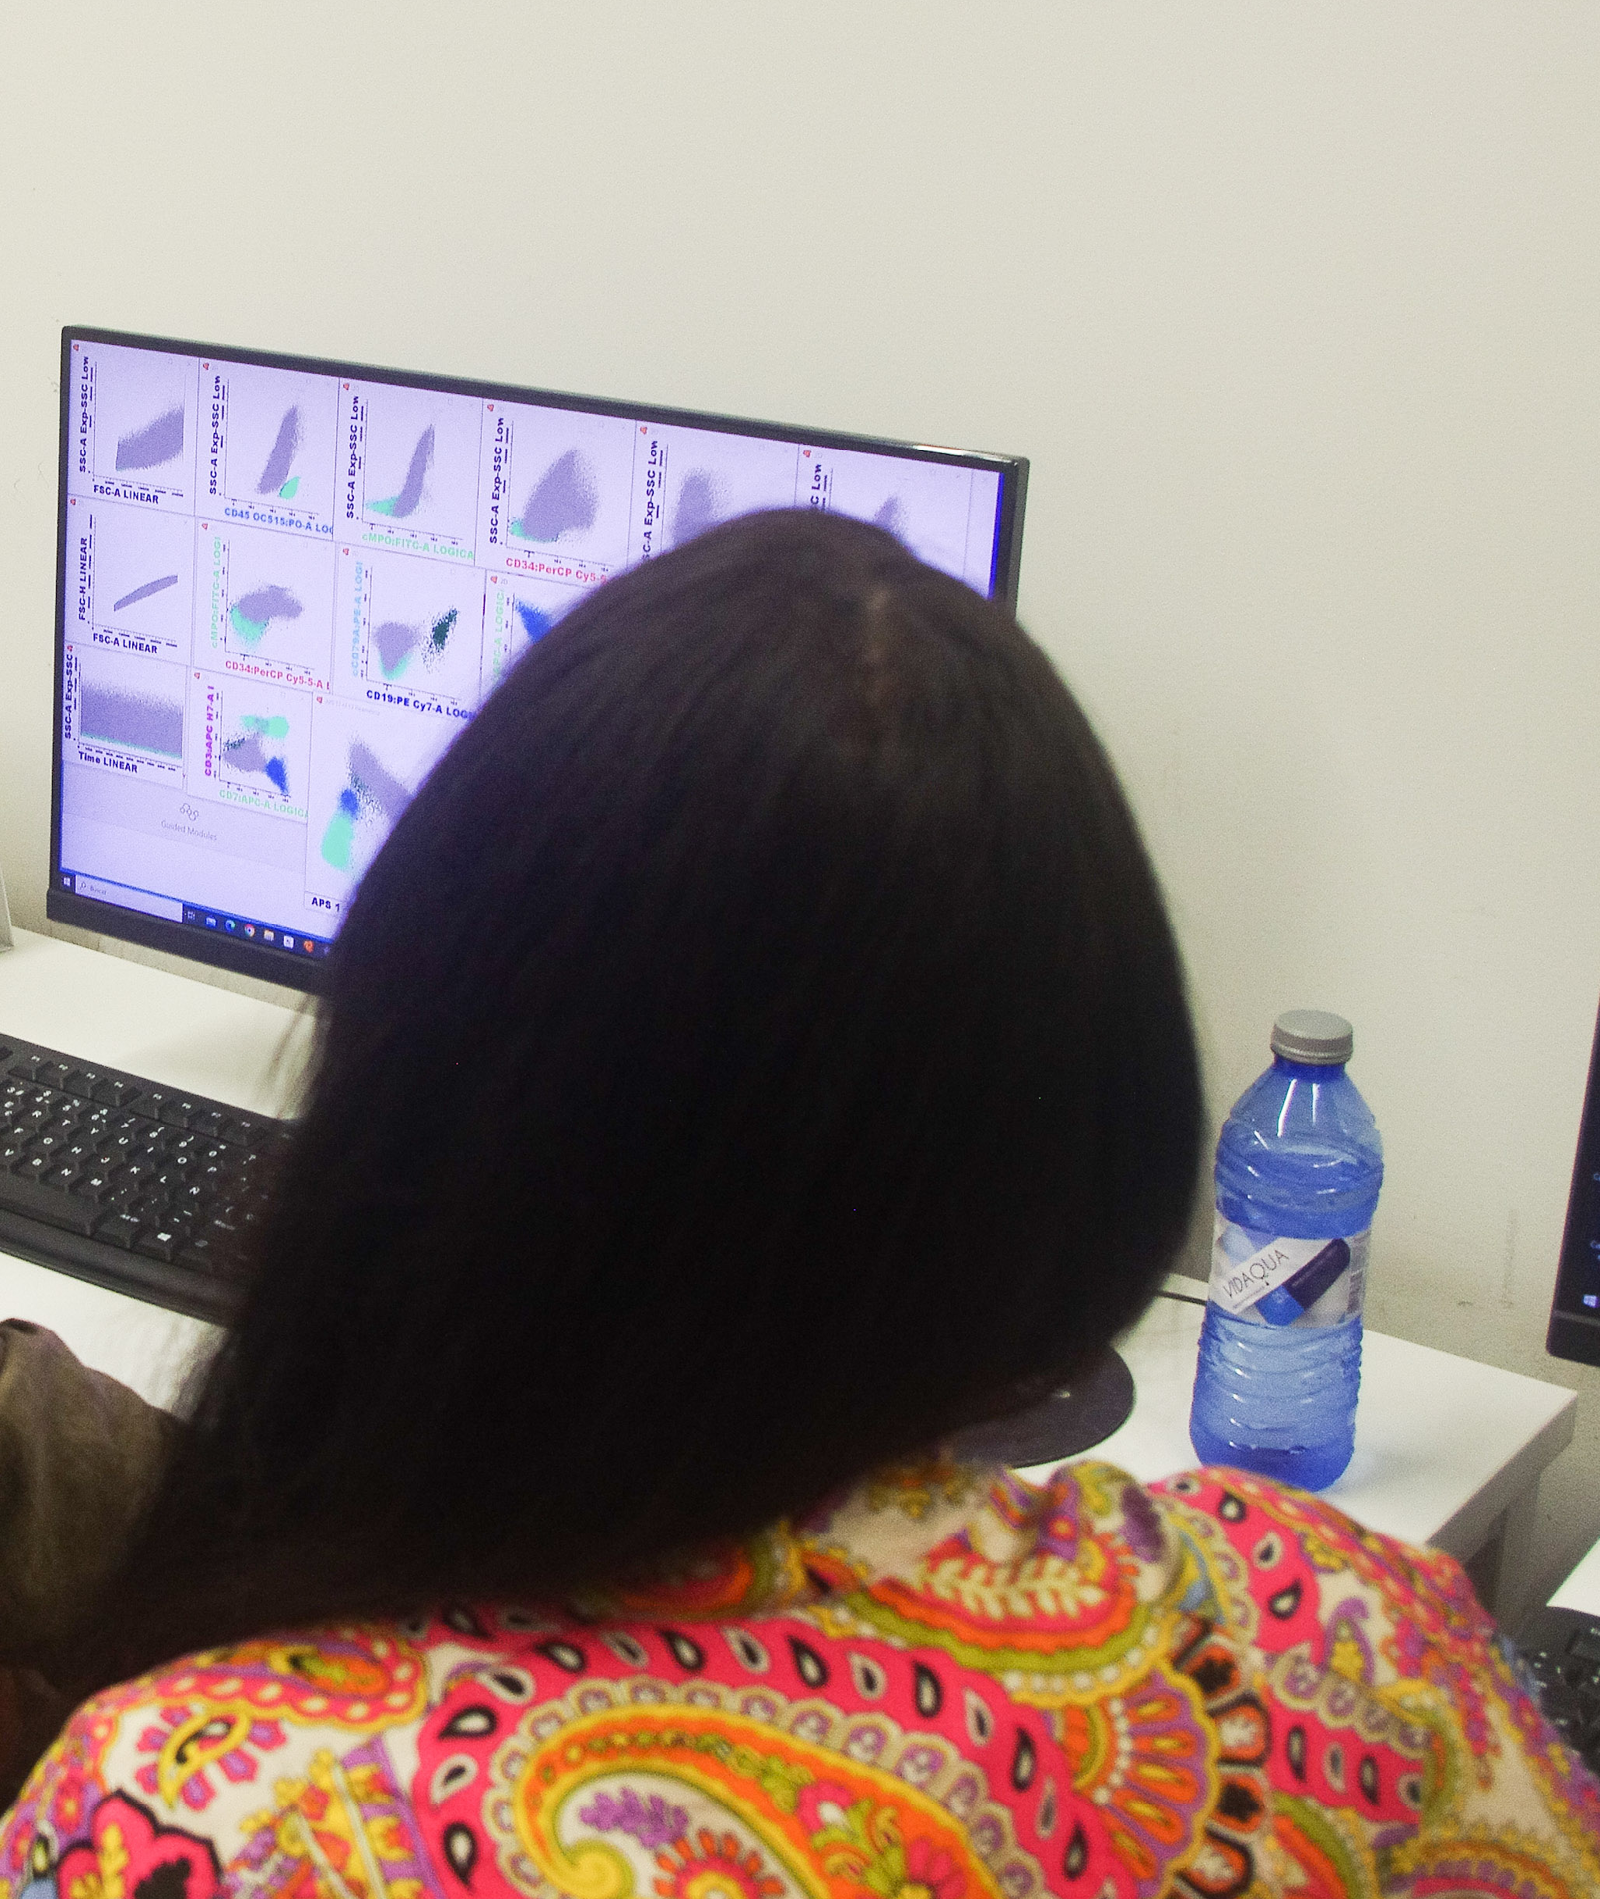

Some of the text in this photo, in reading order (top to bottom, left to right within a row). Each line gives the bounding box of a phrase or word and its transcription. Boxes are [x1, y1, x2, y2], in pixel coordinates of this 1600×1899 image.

[213, 376, 221, 402] Low
[211, 405, 219, 454] Exp-SSC
[79, 435, 87, 472] SSC-A
[346, 396, 359, 518] SSC-A Exp-SSC Low
[490, 418, 504, 543] SSC-A Exp-SSC Low
[645, 440, 658, 525] Exp-SSC Low
[812, 464, 822, 491] Low
[94, 484, 159, 504] FSC-A LINEAR
[225, 507, 249, 520] CD45
[79, 537, 88, 621] FSC-H LINEAR
[506, 558, 572, 577] CD34:PerCP
[93, 633, 157, 653] FSC-A LINEAR
[225, 660, 283, 681] CD34:PerCP
[367, 690, 442, 714] CD19:PE Cy7-A
[78, 751, 138, 774] Time LINEAR
[205, 723, 213, 776] CD3:APC
[311, 896, 331, 909] APS
[1223, 1250, 1289, 1298] VIDAQUA
